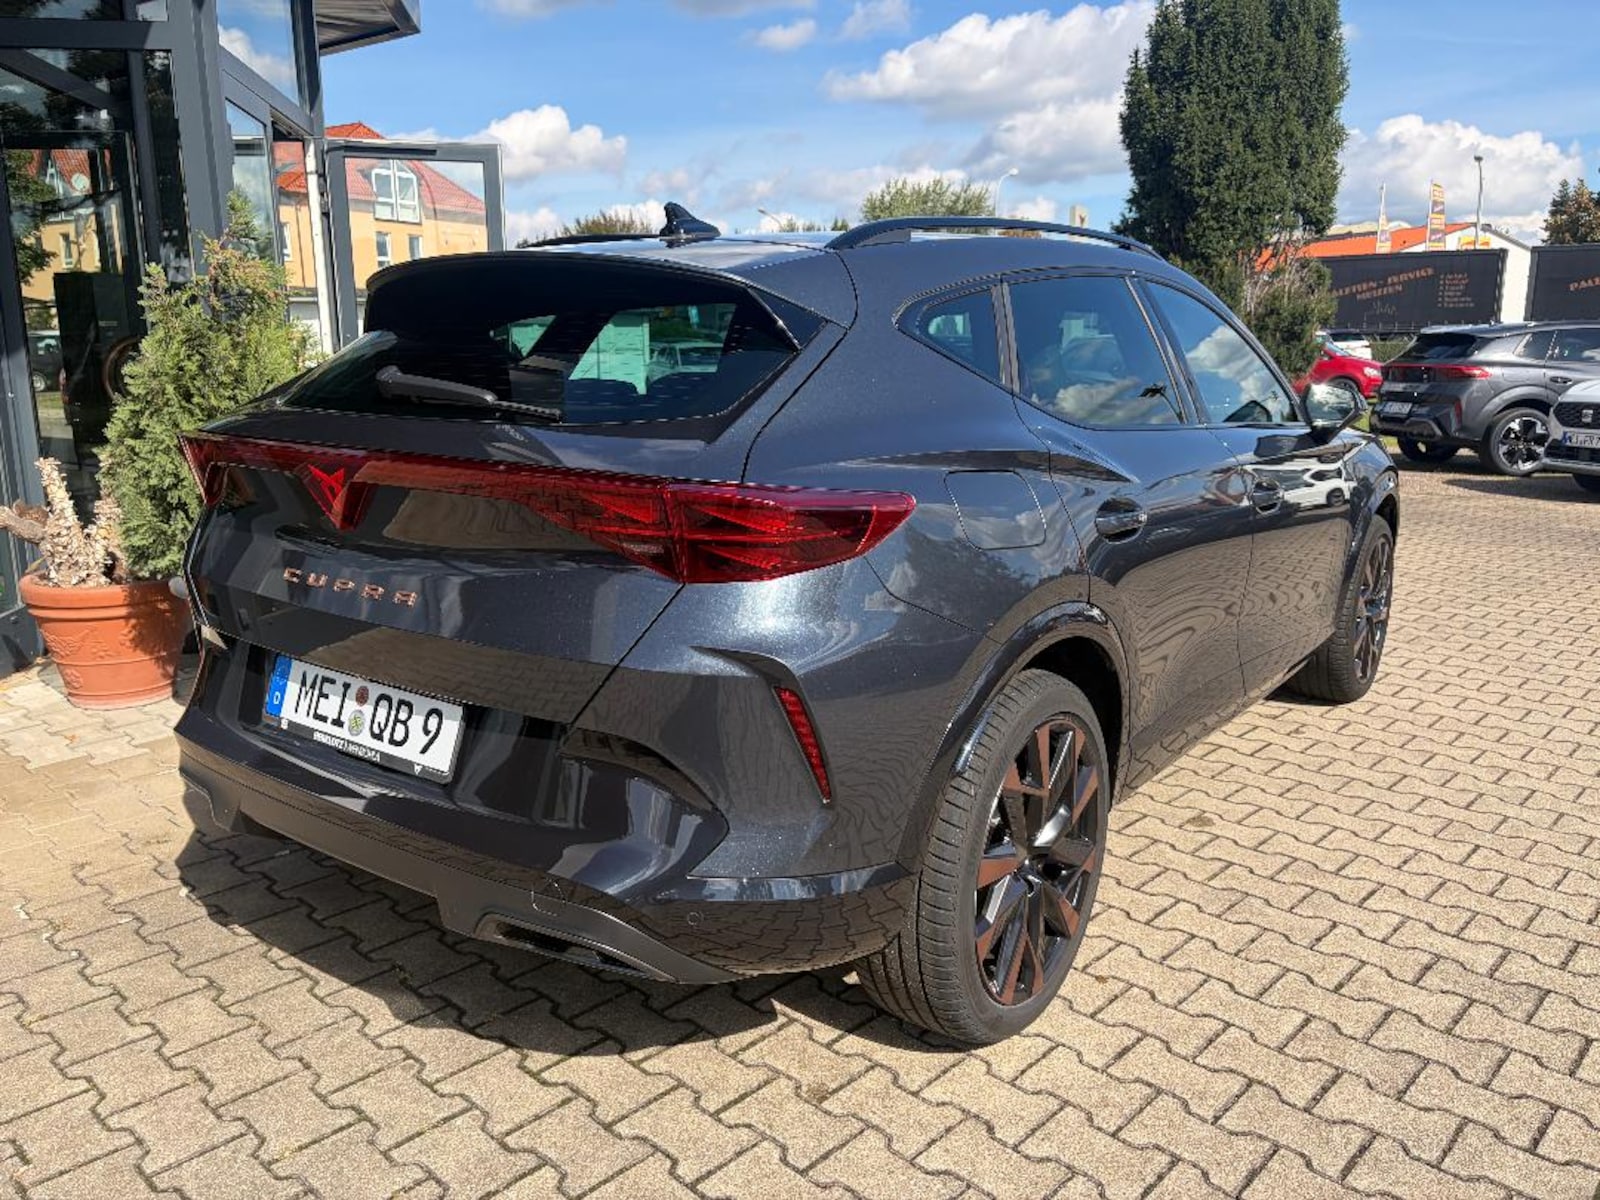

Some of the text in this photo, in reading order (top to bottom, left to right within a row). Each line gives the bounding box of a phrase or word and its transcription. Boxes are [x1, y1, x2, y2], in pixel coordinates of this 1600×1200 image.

[283, 567, 418, 607] CUPRA
[272, 691, 281, 705] D
[294, 670, 352, 729] MEI
[369, 693, 414, 747] QB
[419, 707, 444, 755] 9
